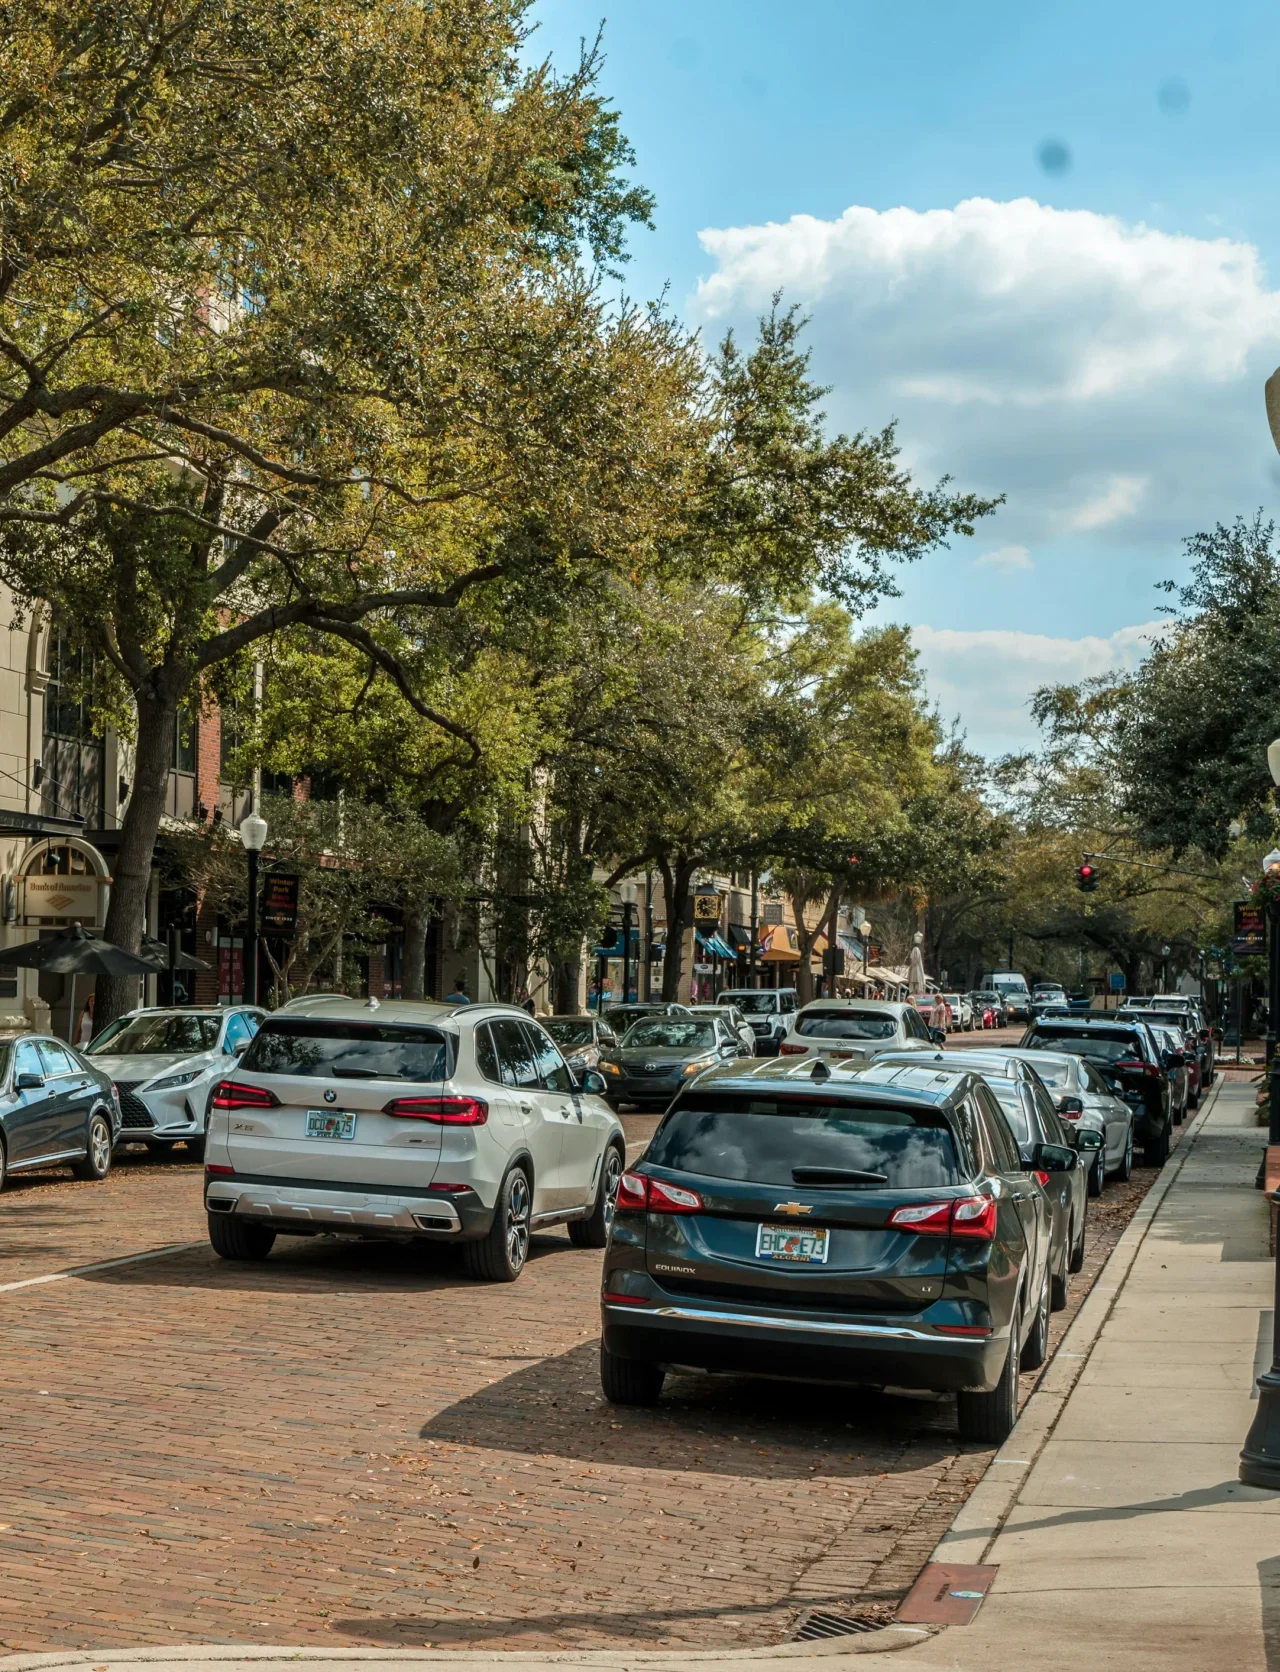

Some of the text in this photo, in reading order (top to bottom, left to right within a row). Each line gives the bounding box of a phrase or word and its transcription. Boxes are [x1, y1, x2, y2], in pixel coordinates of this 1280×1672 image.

[29, 882, 93, 893] Bank of America
[760, 1233, 825, 1255] EHC E73
[772, 1254, 811, 1262] ALUMNI
[655, 1263, 696, 1275] EQUINOX
